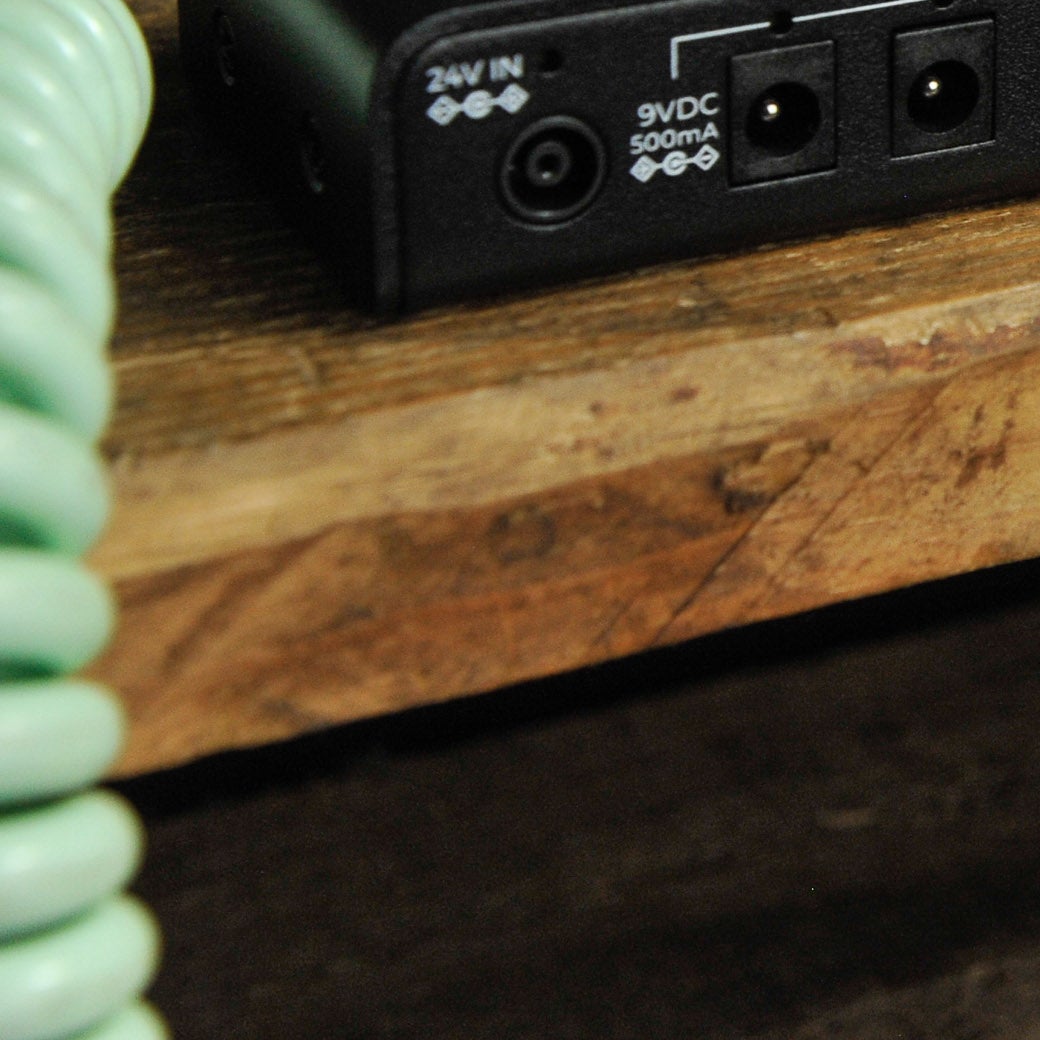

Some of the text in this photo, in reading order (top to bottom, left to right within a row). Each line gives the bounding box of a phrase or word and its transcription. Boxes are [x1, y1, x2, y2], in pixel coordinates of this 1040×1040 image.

[425, 53, 524, 93] 24V IN
[637, 92, 720, 128] 9VDC
[629, 122, 720, 155] 500mA
